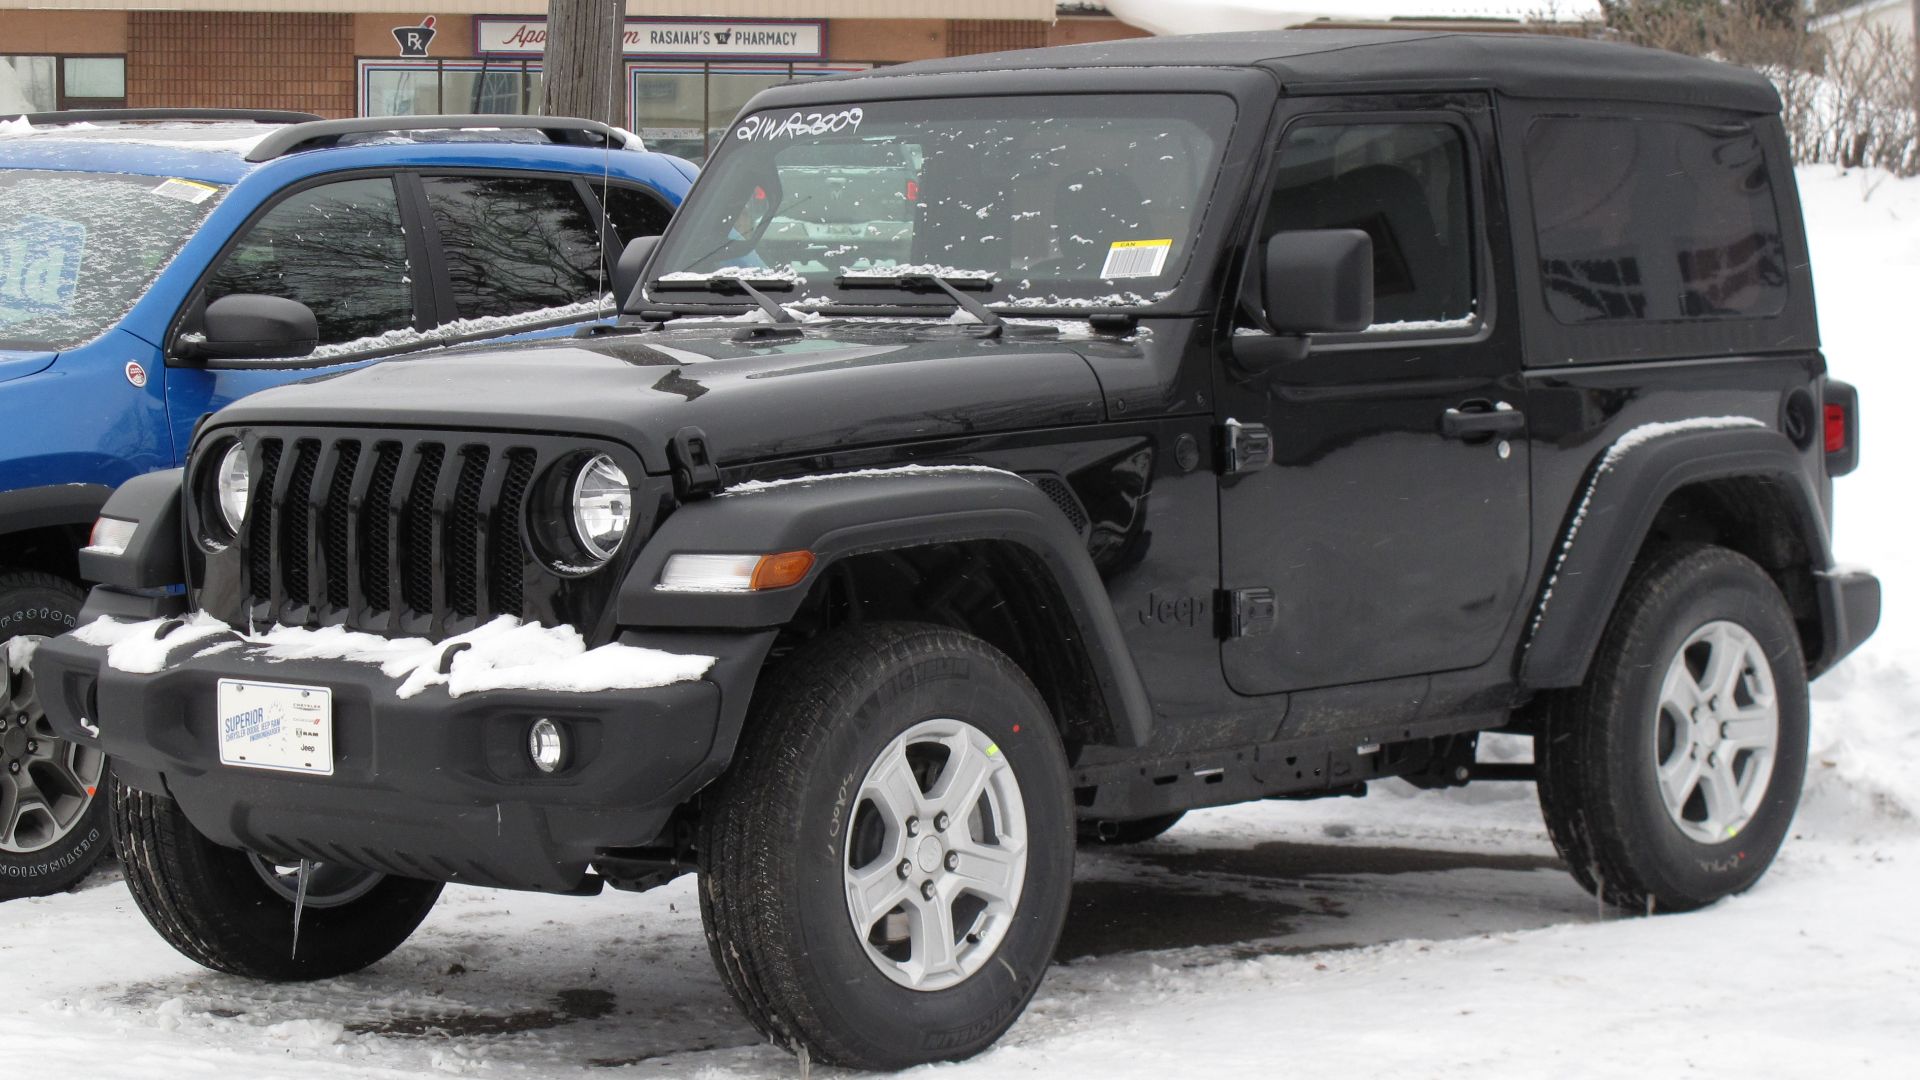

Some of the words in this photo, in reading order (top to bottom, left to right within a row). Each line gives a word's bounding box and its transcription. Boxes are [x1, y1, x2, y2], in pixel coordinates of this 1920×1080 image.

[650, 30, 710, 45] RASAIAH'S
[735, 31, 797, 46] PHARMACY
[1138, 592, 1203, 627] Jeep
[225, 707, 264, 733] SUPERIOR
[300, 743, 315, 752] Jeep
